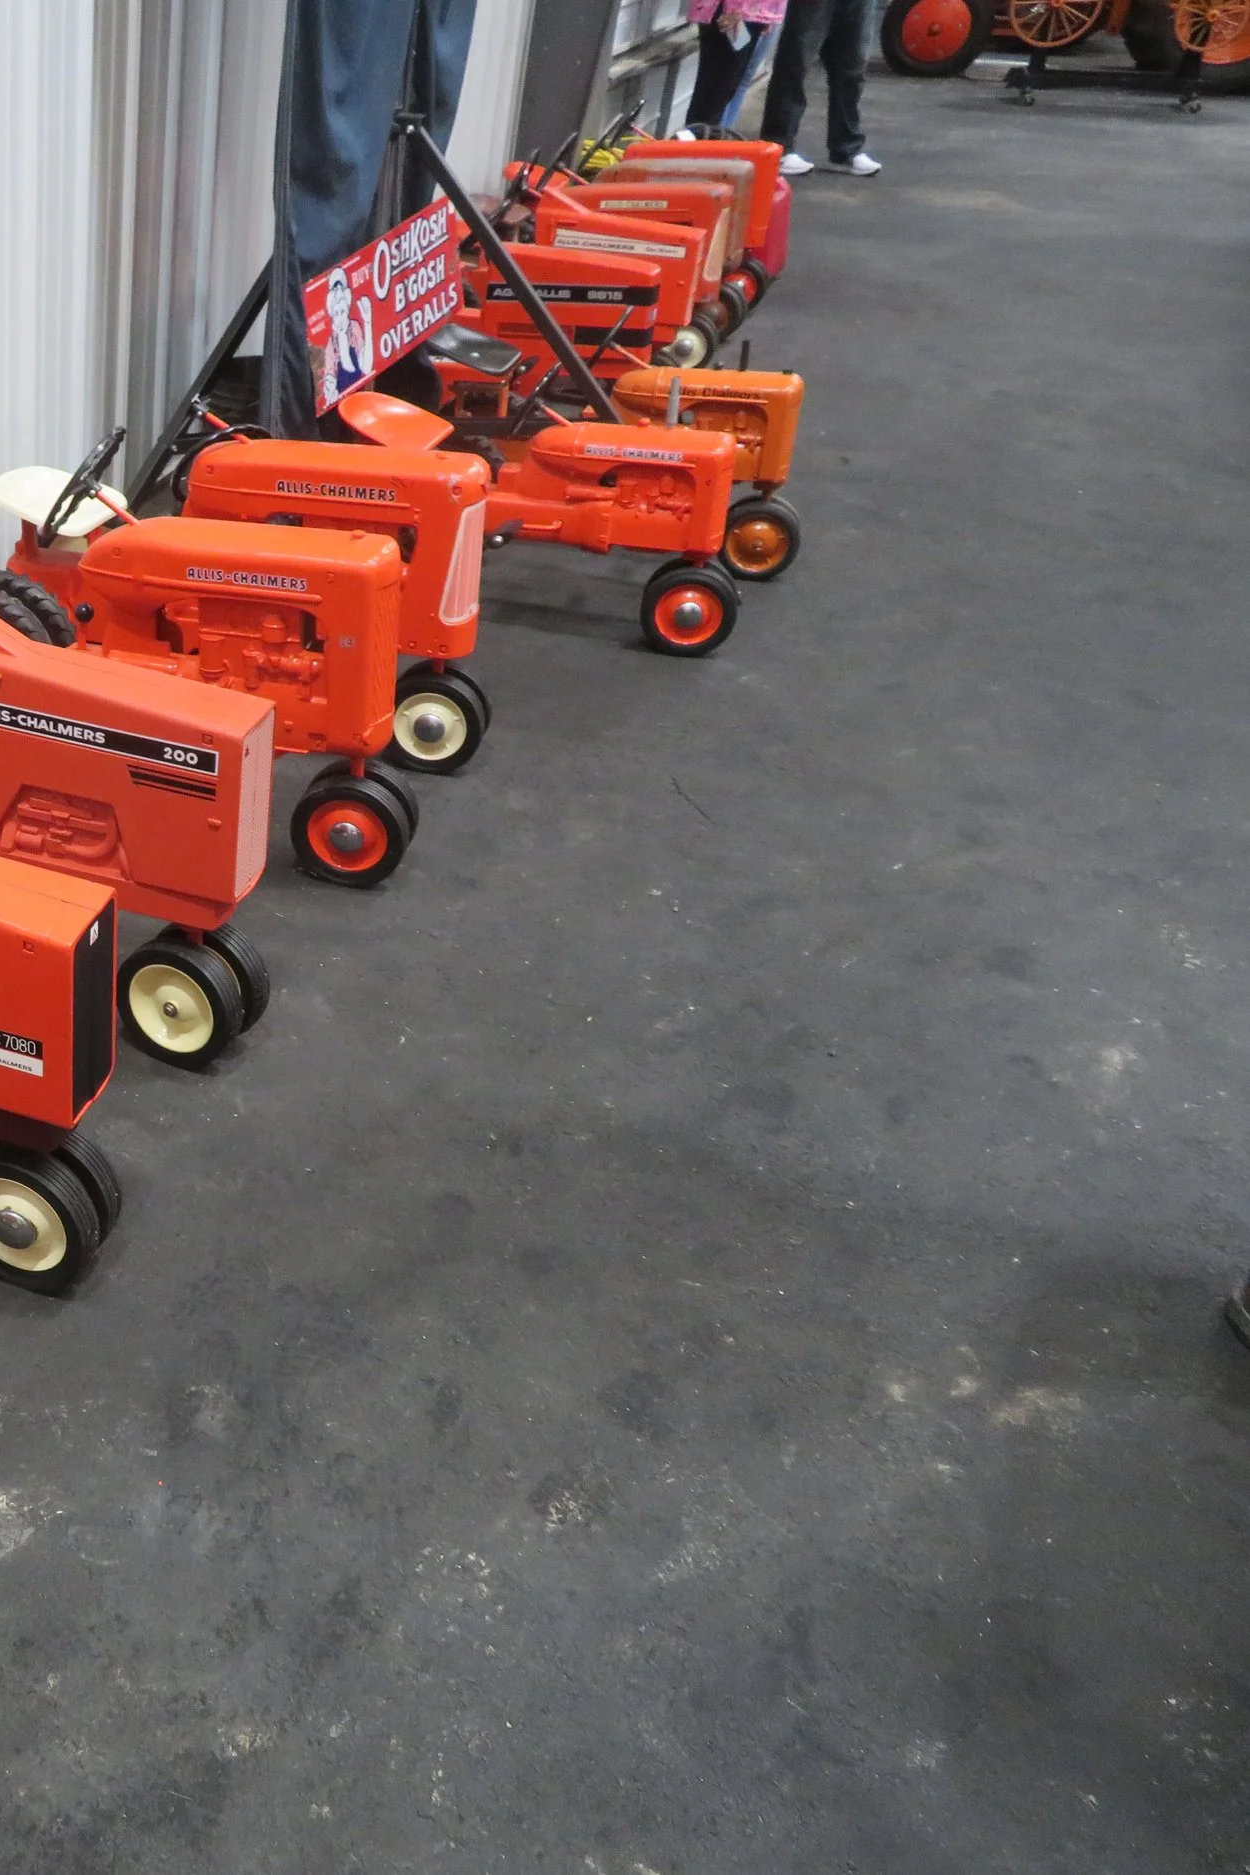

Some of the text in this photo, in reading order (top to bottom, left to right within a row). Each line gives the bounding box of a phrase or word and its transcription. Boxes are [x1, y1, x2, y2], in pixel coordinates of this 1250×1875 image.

[352, 263, 371, 289] BUY
[395, 254, 445, 312] B'GOSH
[380, 282, 458, 358] OVERALLS
[163, 746, 199, 765] 200
[2, 1033, 37, 1056] 7080
